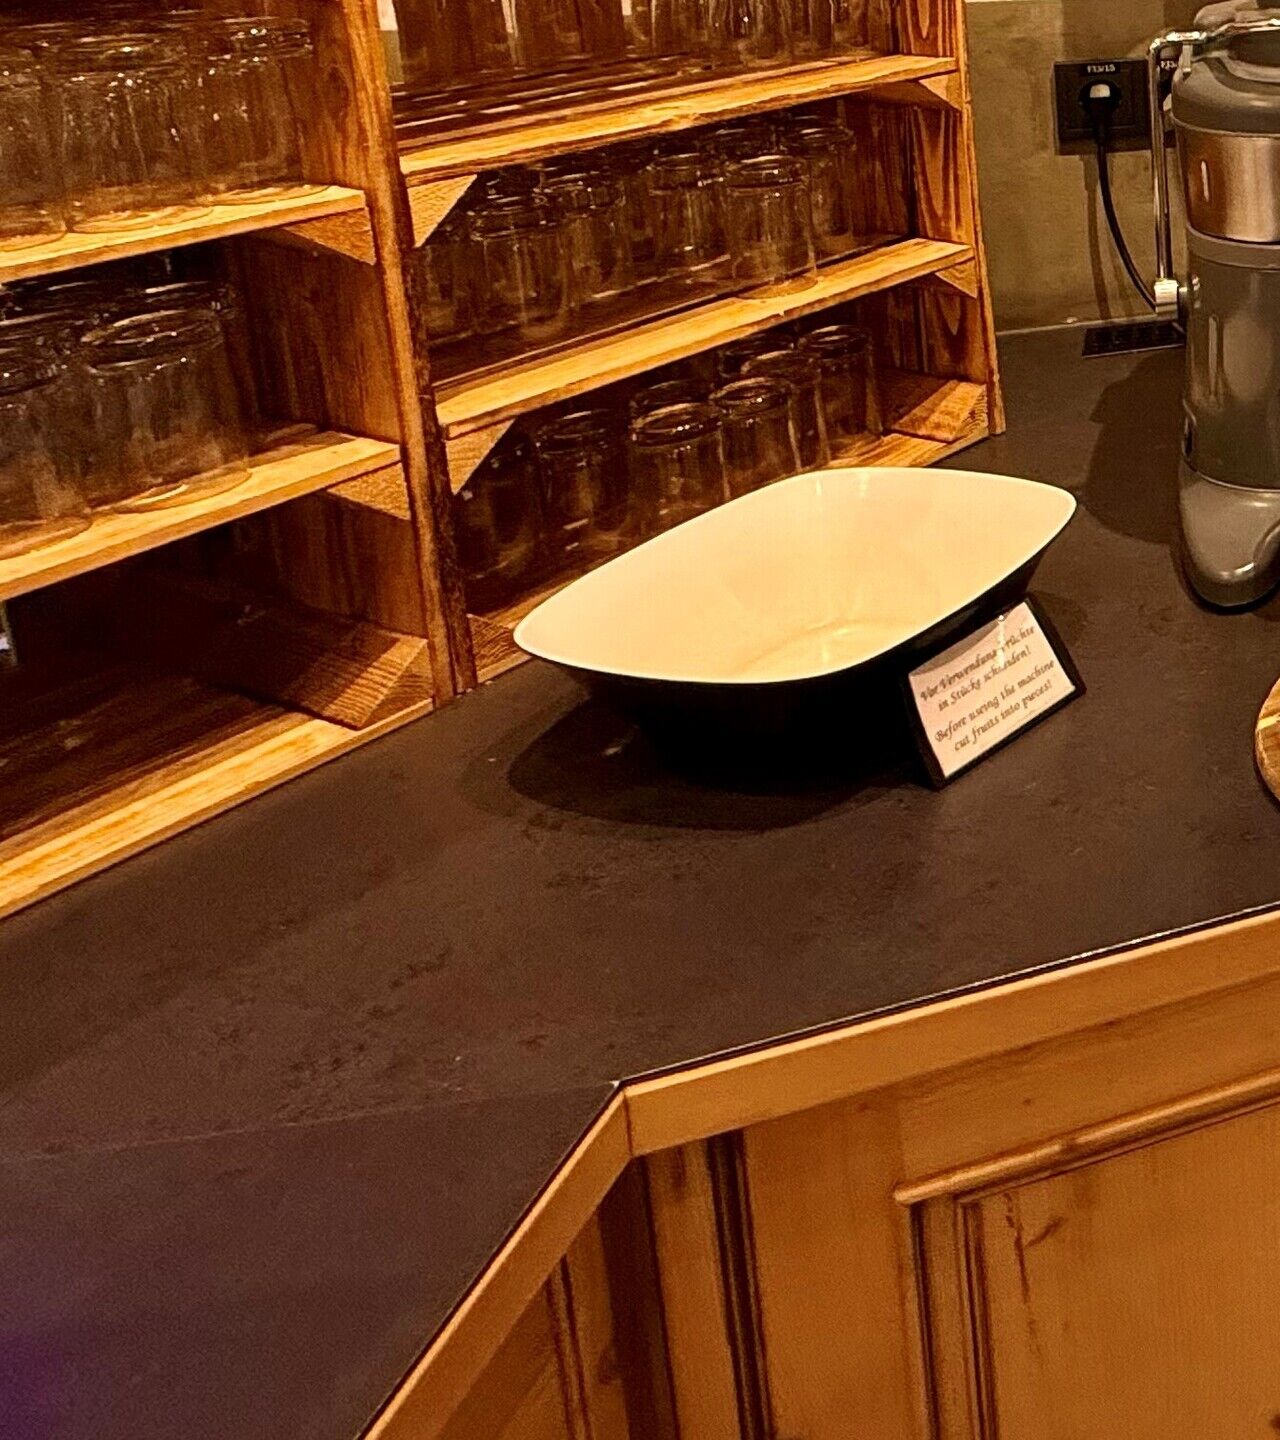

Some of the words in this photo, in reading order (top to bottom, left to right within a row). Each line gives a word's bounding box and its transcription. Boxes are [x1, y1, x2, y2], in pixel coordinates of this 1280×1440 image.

[935, 717, 967, 742] Before
[1000, 683, 1016, 701] the
[1017, 659, 1055, 689] machine
